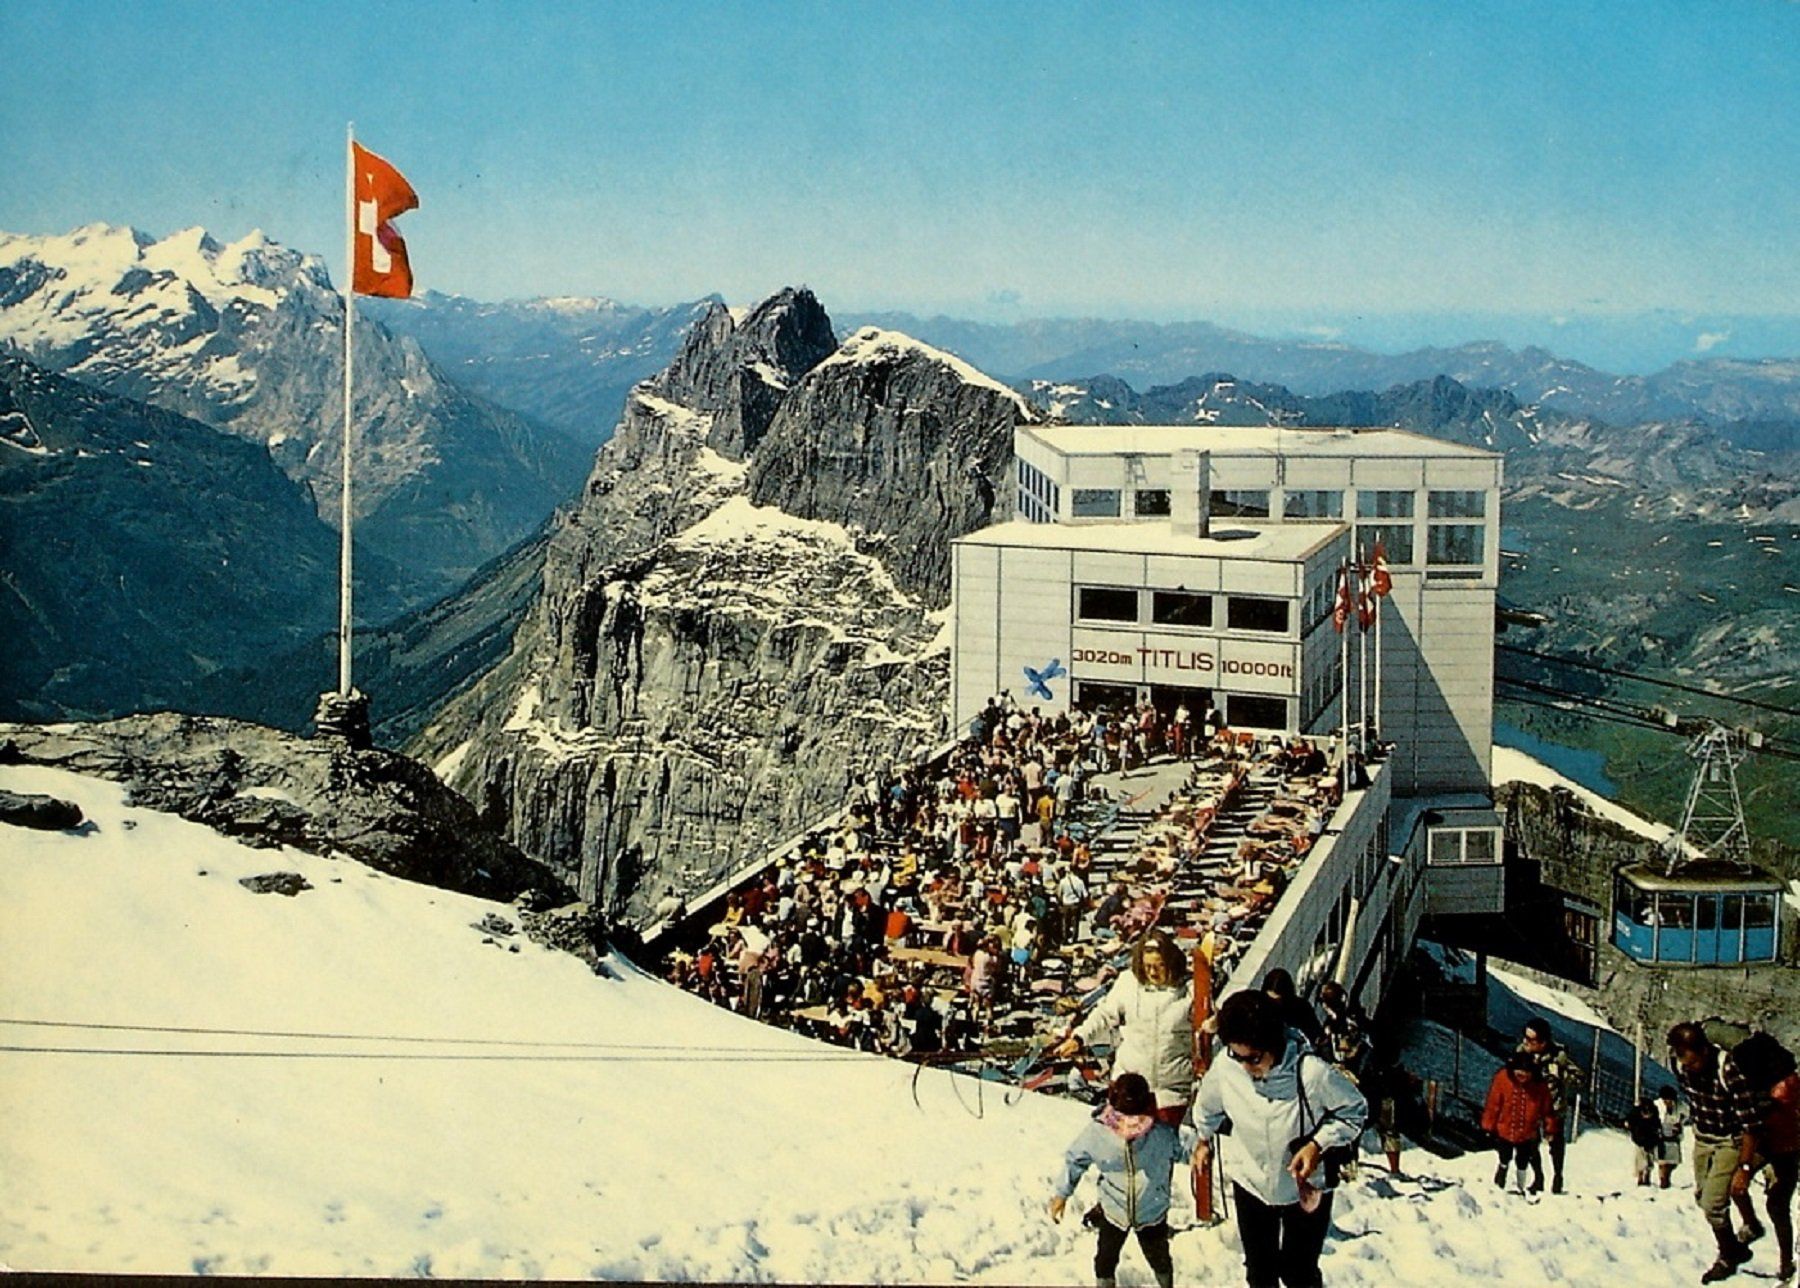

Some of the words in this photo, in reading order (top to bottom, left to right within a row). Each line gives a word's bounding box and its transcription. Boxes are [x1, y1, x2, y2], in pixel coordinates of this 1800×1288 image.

[1073, 649, 1132, 664] 3020m
[1137, 648, 1214, 671] TITLIS
[1222, 660, 1292, 678] 10000ft
